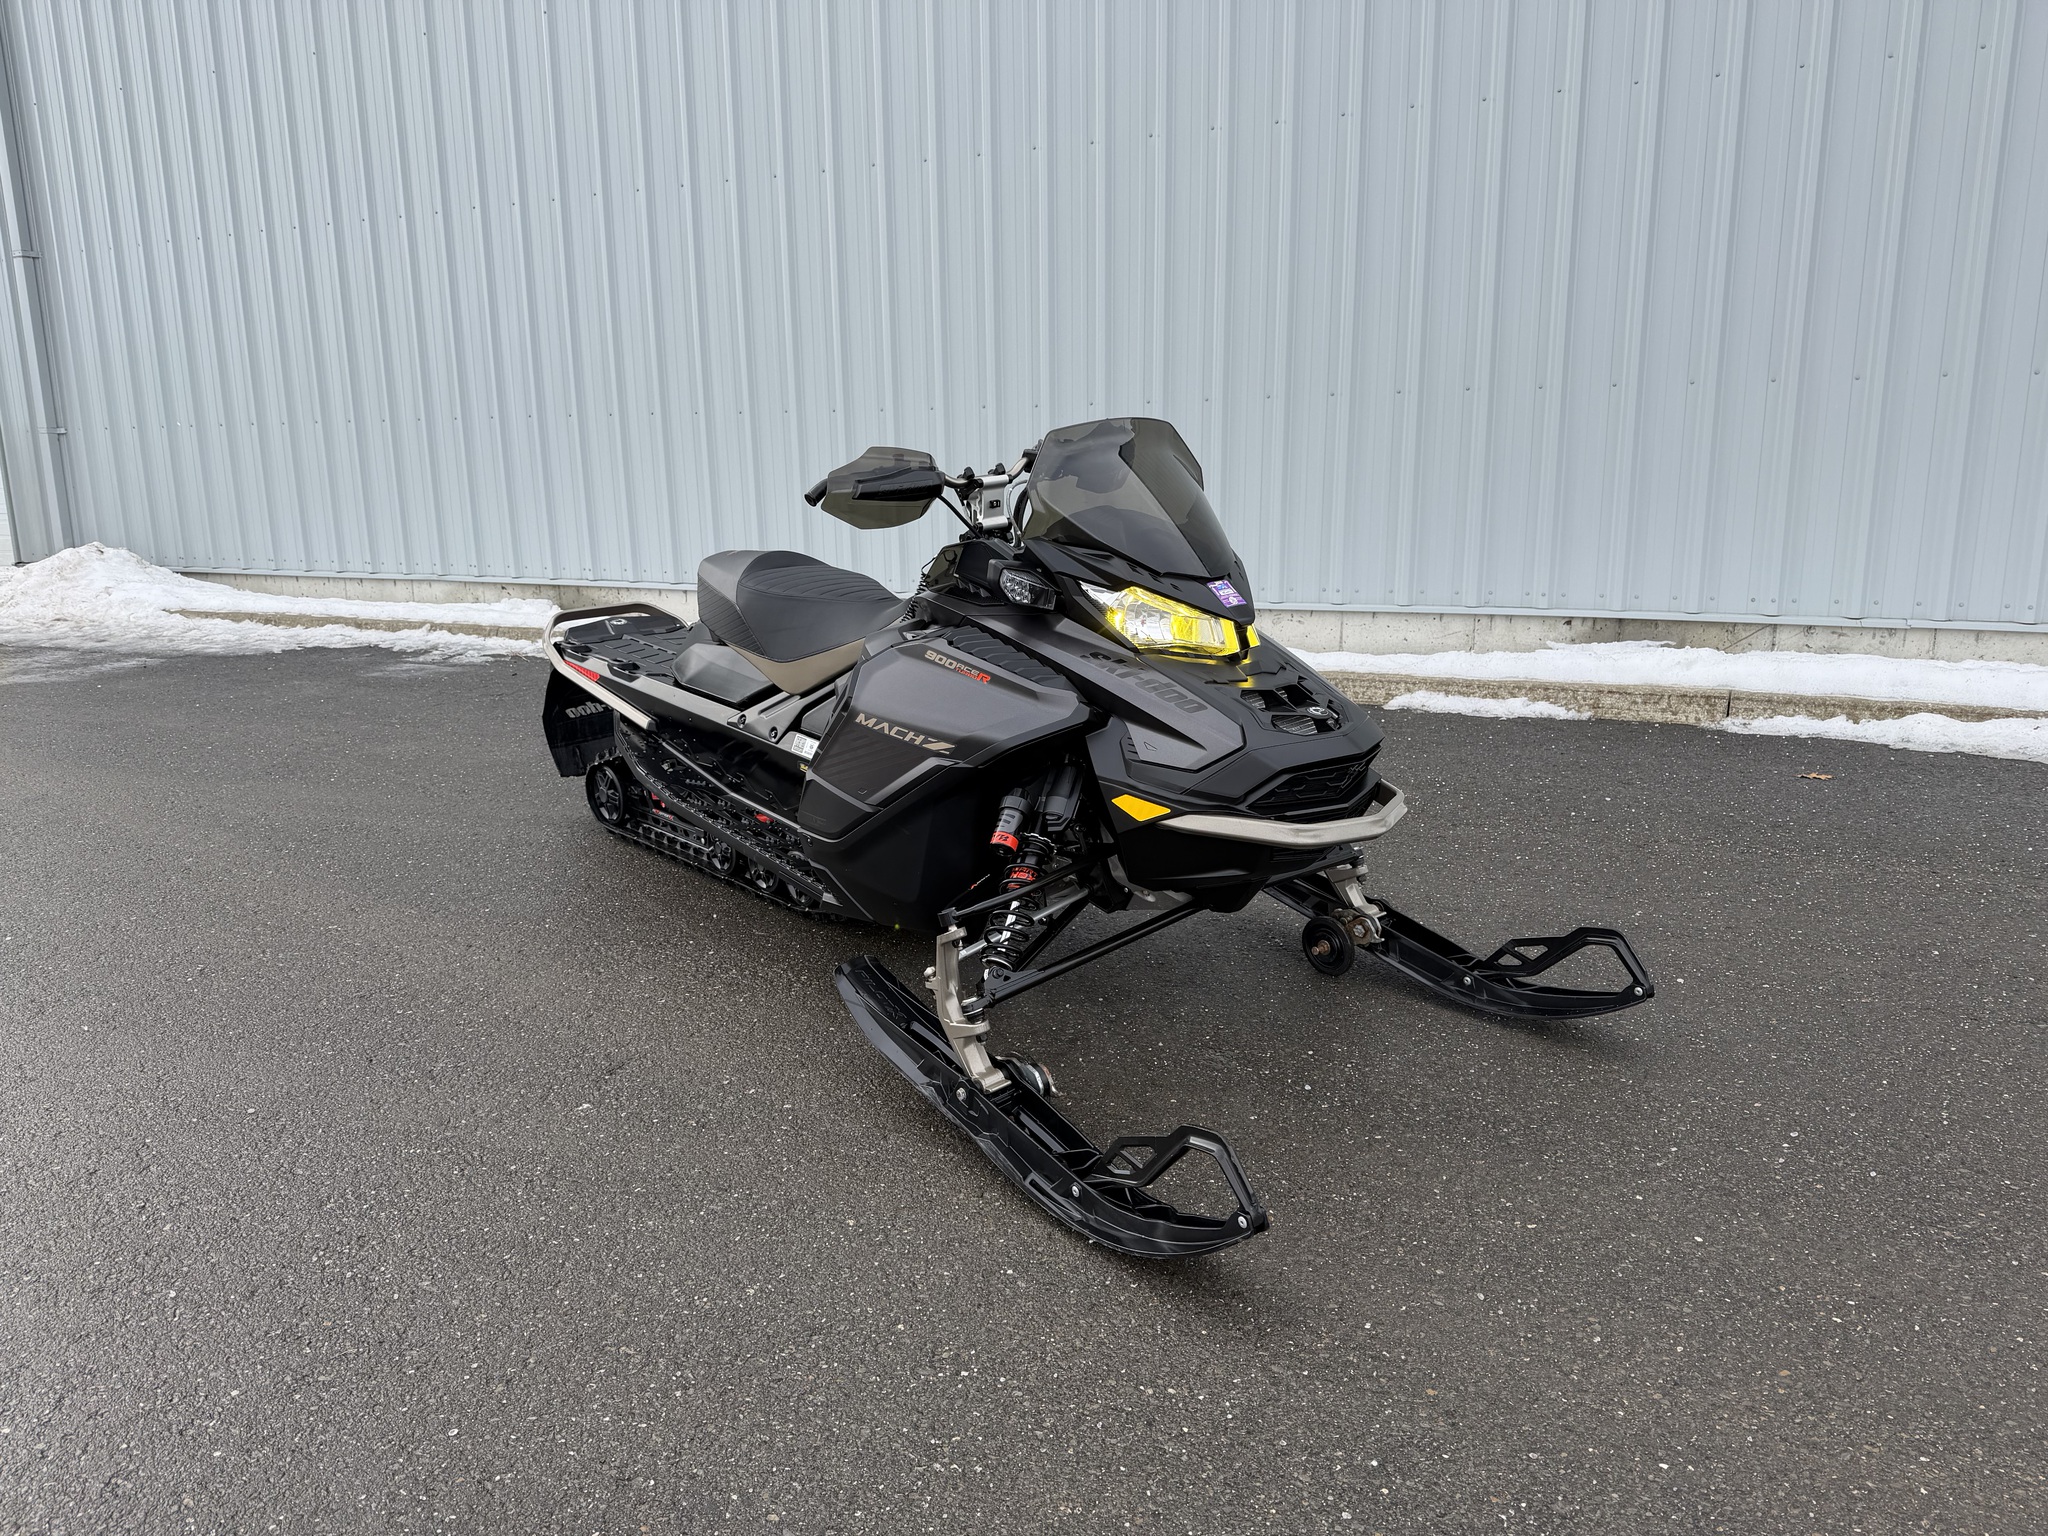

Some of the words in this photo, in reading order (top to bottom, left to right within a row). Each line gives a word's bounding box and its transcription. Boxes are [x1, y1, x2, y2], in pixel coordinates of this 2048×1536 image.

[924, 650, 957, 670] 900
[976, 672, 992, 685] R
[855, 713, 926, 746] MACH
[922, 737, 956, 755] Z
